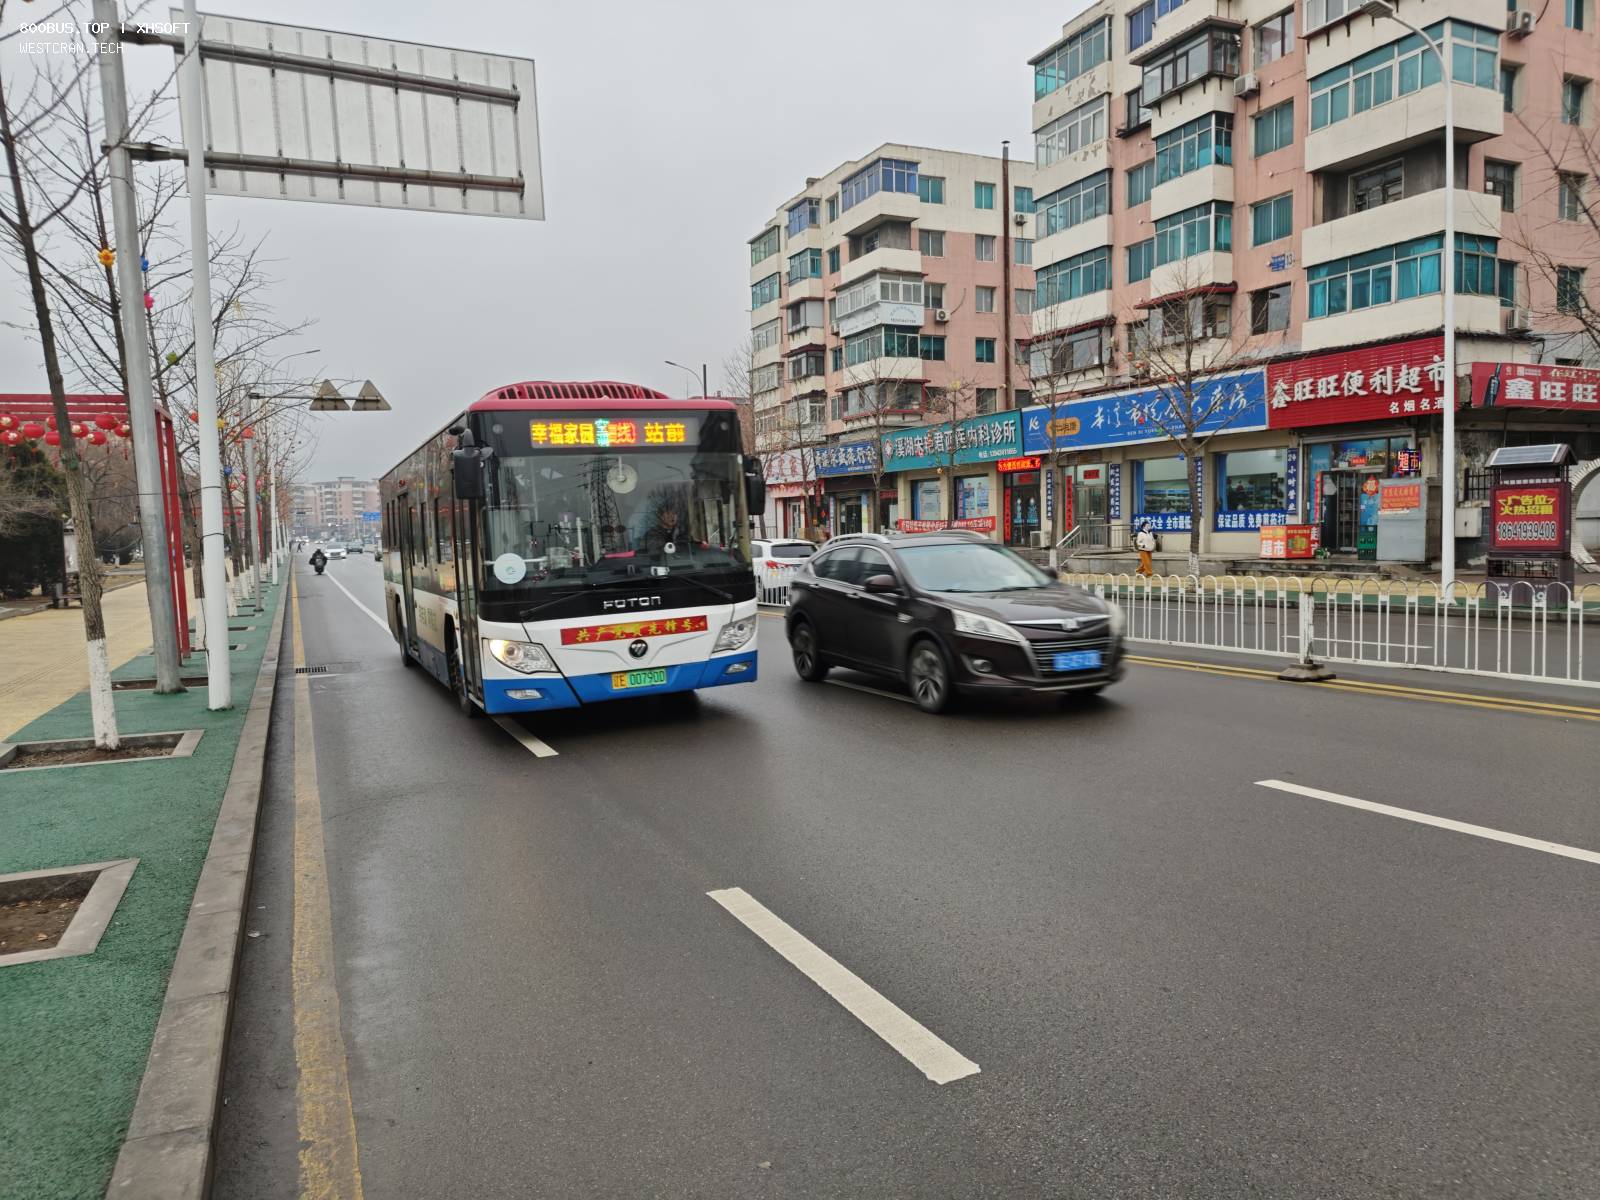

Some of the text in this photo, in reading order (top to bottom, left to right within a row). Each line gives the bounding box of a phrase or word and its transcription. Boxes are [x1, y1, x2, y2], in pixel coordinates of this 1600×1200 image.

[1272, 355, 1445, 410] 鑫旺旺便利超市
[1505, 377, 1598, 403] 鑫旺旺
[644, 421, 686, 444] 站前
[1398, 451, 1419, 470] 超市
[1217, 513, 1246, 529] 保证品质
[603, 596, 662, 609] FOTON
